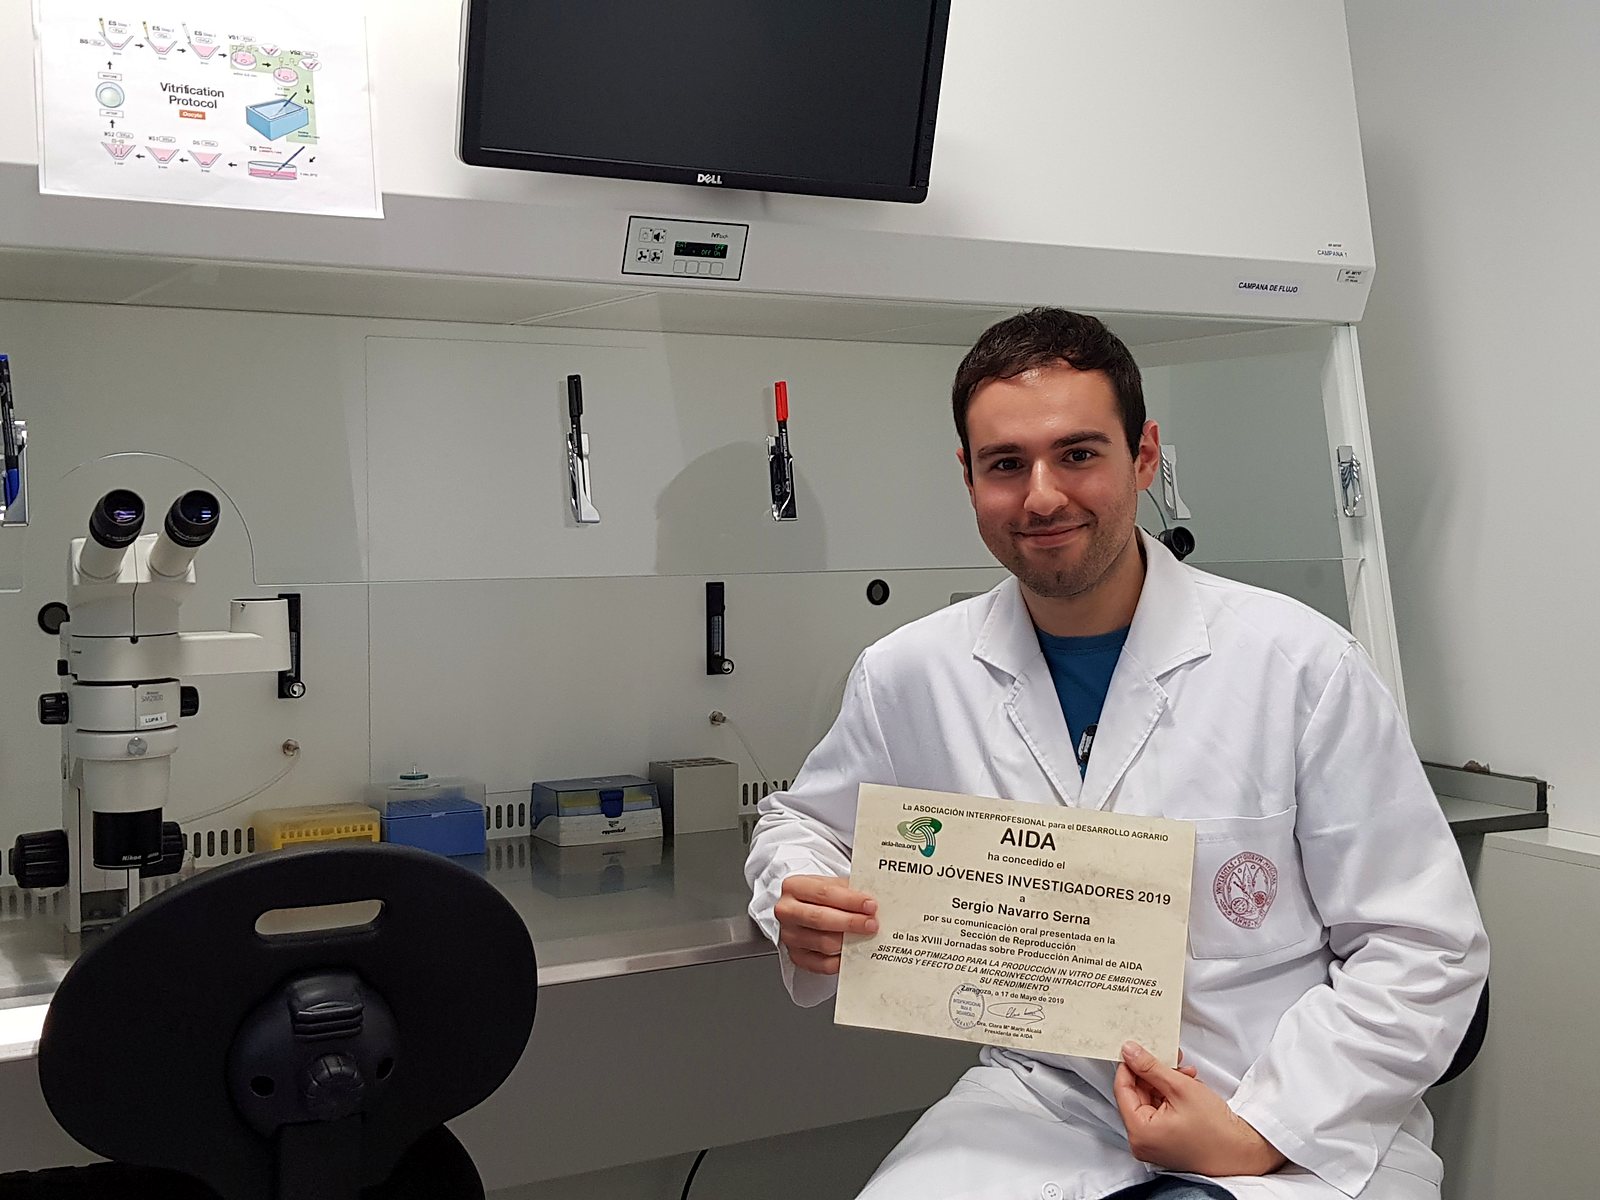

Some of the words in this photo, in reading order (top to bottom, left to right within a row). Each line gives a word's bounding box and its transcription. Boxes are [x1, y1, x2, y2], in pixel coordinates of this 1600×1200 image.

[160, 81, 224, 98] Vitrification
[169, 95, 217, 109] Protocol
[697, 173, 722, 185] DELL
[1317, 249, 1343, 257] CAMPANA
[1238, 281, 1268, 291] CAMPANA
[1269, 284, 1278, 292] DE
[1278, 285, 1298, 293] FLUJO
[902, 803, 912, 811] La
[914, 804, 964, 817] ASOCIACIÓN
[966, 810, 1046, 827] INTERPROFESIONAL
[1048, 820, 1066, 830] para
[1076, 823, 1130, 837] DESARROLLO
[1131, 831, 1169, 842] AGRARIO
[1000, 827, 1056, 851] AIDA
[987, 851, 1000, 862] ha
[1002, 854, 1054, 869] concedido
[1056, 861, 1065, 870] el
[878, 859, 933, 876] PREMIO
[937, 865, 1004, 885] JÓVENES
[1007, 875, 1134, 901] INVESTIGADORES
[1137, 891, 1171, 906] 2019
[1019, 895, 1026, 903] a
[951, 897, 994, 914] Sergio
[998, 903, 1049, 921] Navarro
[1053, 910, 1091, 925] Serna
[923, 913, 939, 922] por
[941, 916, 952, 924] su
[954, 917, 1018, 933] comunicación
[1019, 926, 1038, 935] oral
[1039, 928, 1091, 942] presentada
[1093, 936, 1105, 944] en
[1107, 936, 1116, 945] la
[960, 928, 997, 941] Sección
[999, 934, 1011, 943] de
[1012, 936, 1076, 952] Reproducción
[892, 932, 904, 940] de
[906, 933, 919, 943] las
[920, 935, 942, 946] XVIII
[944, 938, 987, 952] Jornadas
[989, 944, 1015, 956] sobre
[1017, 948, 1069, 962] Producción
[1071, 955, 1104, 966] Animal
[1105, 959, 1117, 968] de
[1119, 961, 1143, 971] AIDA
[870, 953, 914, 965] PORCINOS
[921, 959, 954, 970] EFECTO
[954, 964, 967, 972] DE
[967, 965, 979, 973] LA
[979, 966, 1052, 983] MICROINYECCIÓN
[1052, 977, 1149, 996] INTRACITOPLASMÁTICA
[1150, 989, 1163, 997] EN
[877, 944, 913, 955] SISTEMA
[914, 949, 965, 963] OPTIMIZADO
[965, 956, 987, 966] PARA
[988, 959, 1000, 968] LA
[1001, 960, 1057, 975] PRODUCCIÓN
[1057, 968, 1067, 976] IN
[1068, 969, 1094, 980] VITRO
[1094, 973, 1106, 981] DE
[1107, 975, 1158, 987] EMBRIONES
[961, 985, 993, 997] Zaragoza,
[1020, 993, 1037, 1002] Mayo
[1048, 996, 1064, 1005] 2019
[979, 976, 991, 985] SU
[992, 977, 1050, 992] RENDIMIENTO
